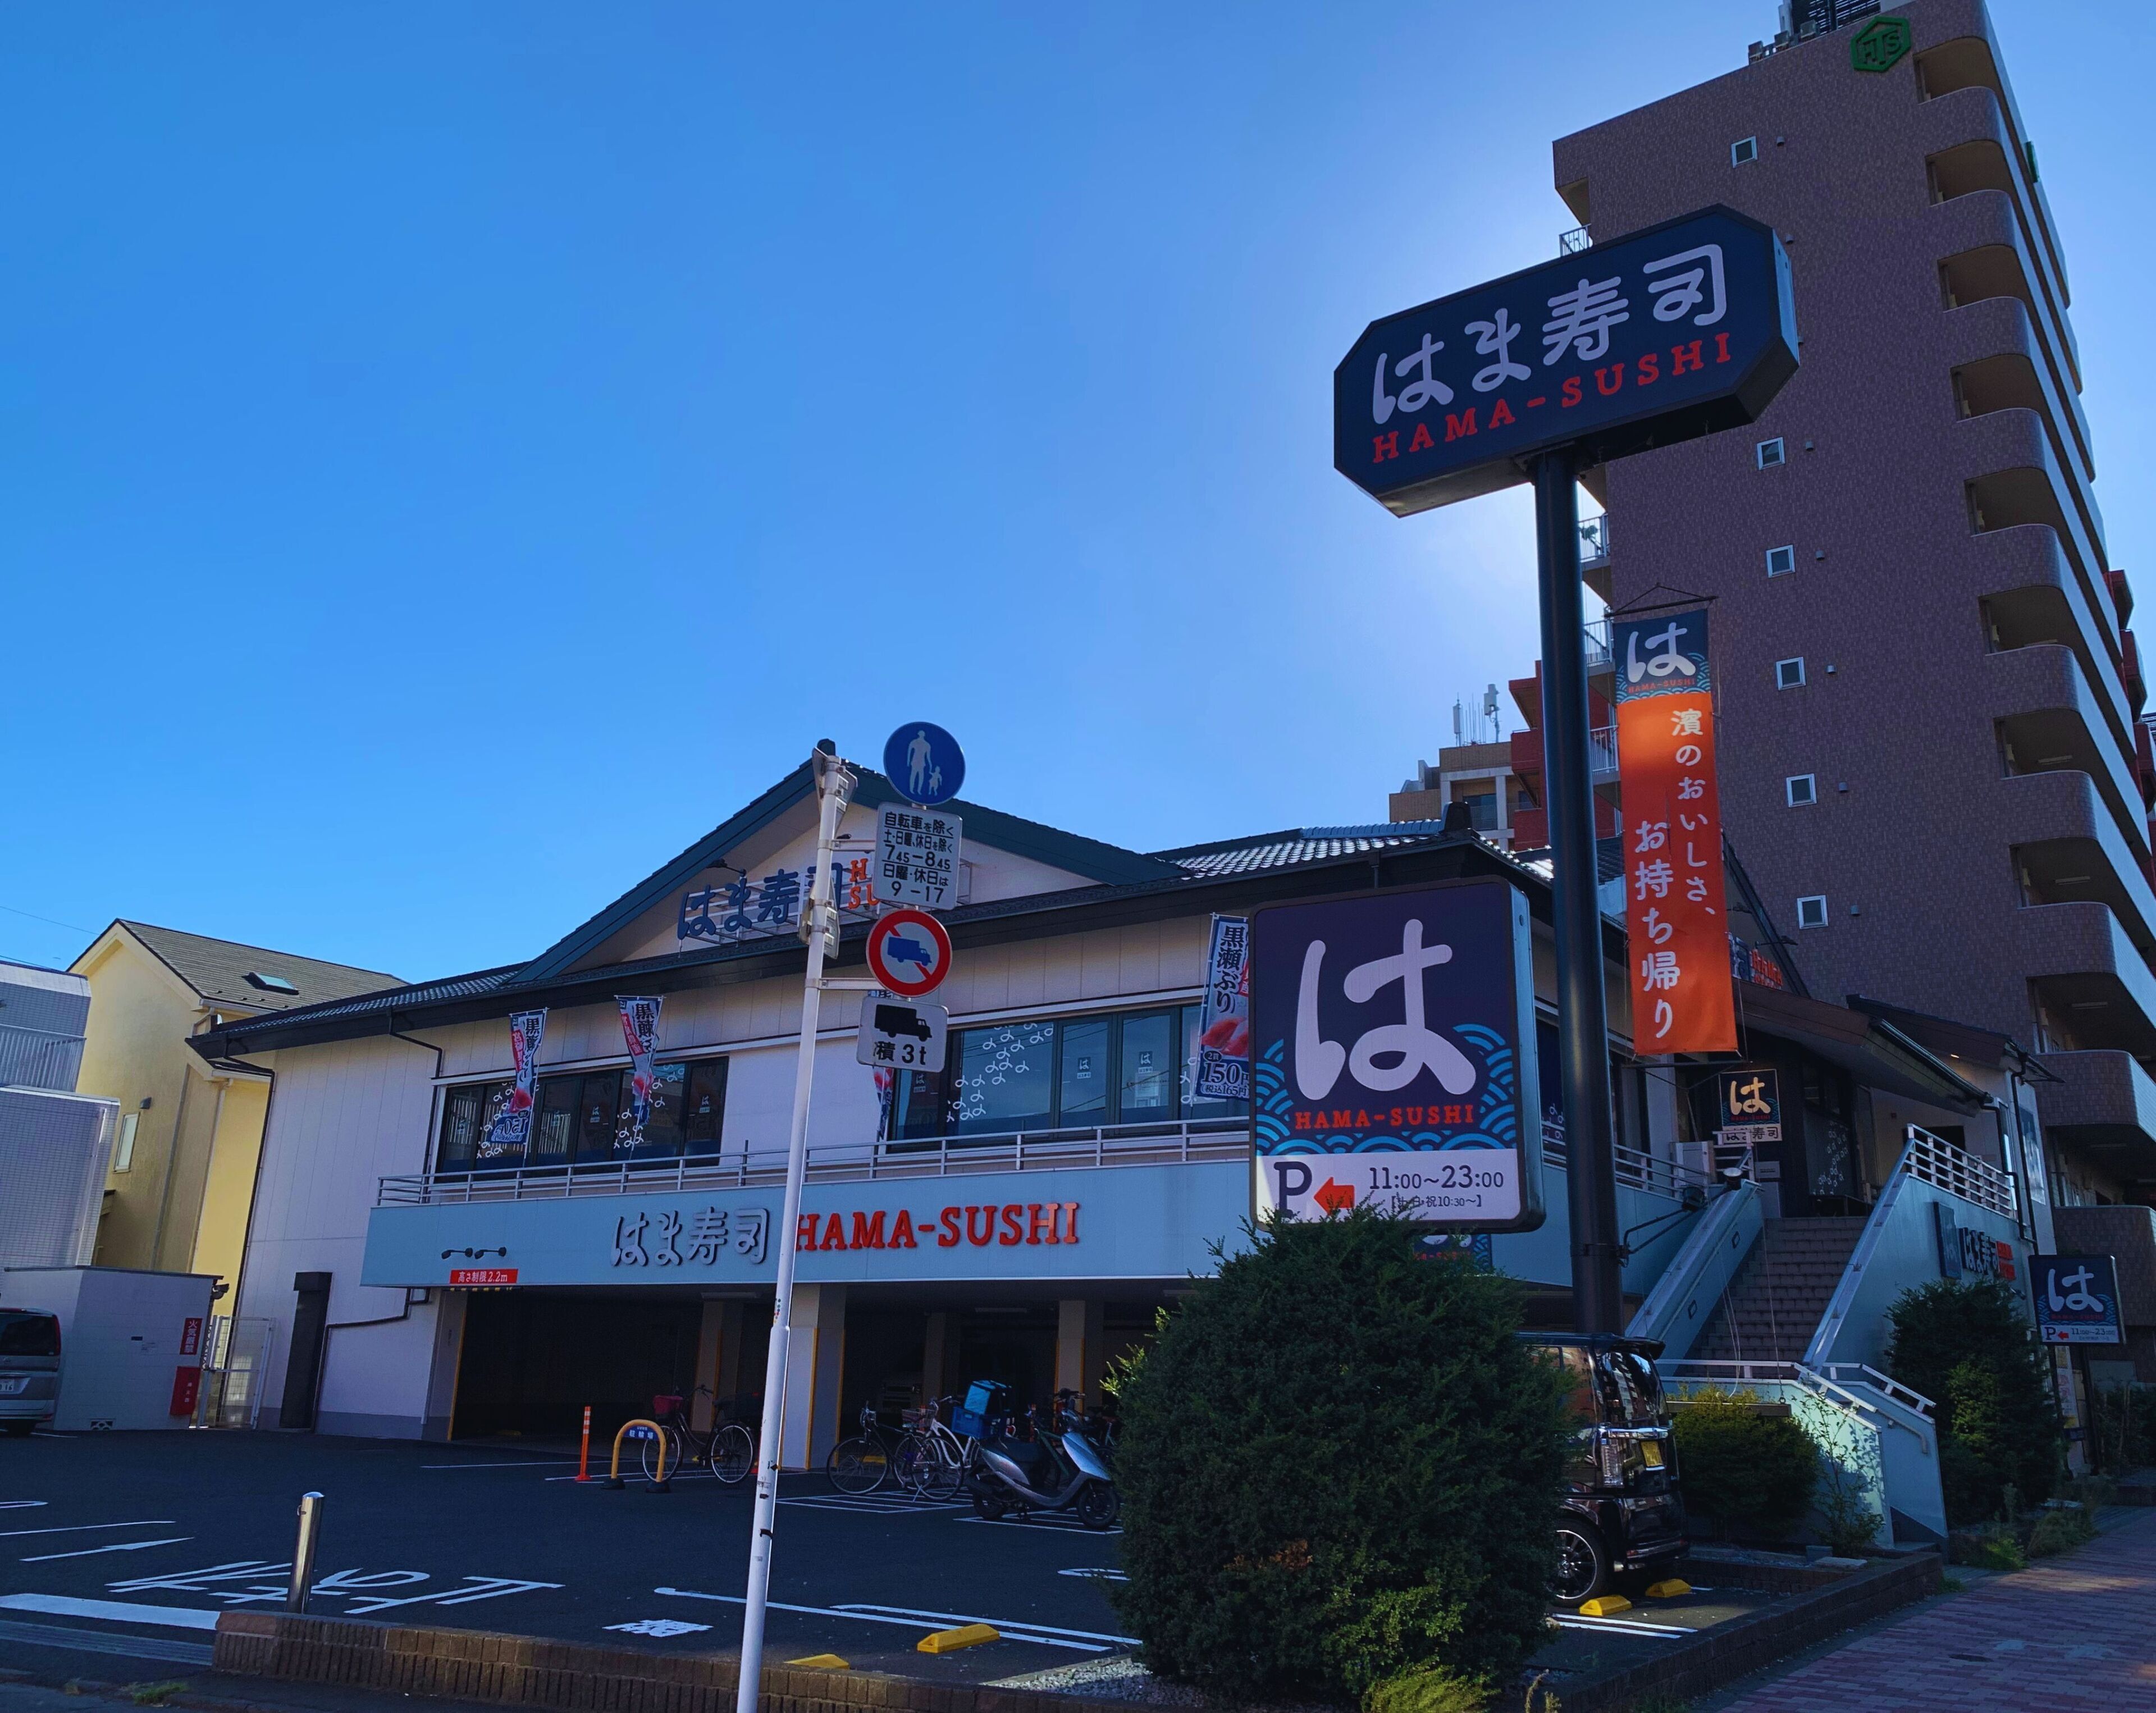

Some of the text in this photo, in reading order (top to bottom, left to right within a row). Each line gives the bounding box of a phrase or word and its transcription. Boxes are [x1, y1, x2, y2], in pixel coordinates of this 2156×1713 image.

[1373, 244, 1726, 424] はま寿司
[1373, 332, 1731, 463] HAMA-SUSHI
[1627, 622, 1696, 683] は
[885, 812, 953, 836] 自転車を除く
[1635, 820, 1680, 1038] お持ち帰り
[1214, 925, 1245, 1013] 黒瀬ぶり
[1295, 919, 1476, 1100] は
[1295, 1104, 1475, 1130] HAMA-SUSHI
[1730, 1076, 1771, 1115] は
[1273, 1161, 1313, 1217] P
[611, 1206, 770, 1267] はま寿司
[796, 1202, 1079, 1251] HAMA-SUSHI
[2048, 1266, 2104, 1312] は
[2045, 1327, 2056, 1340] P
